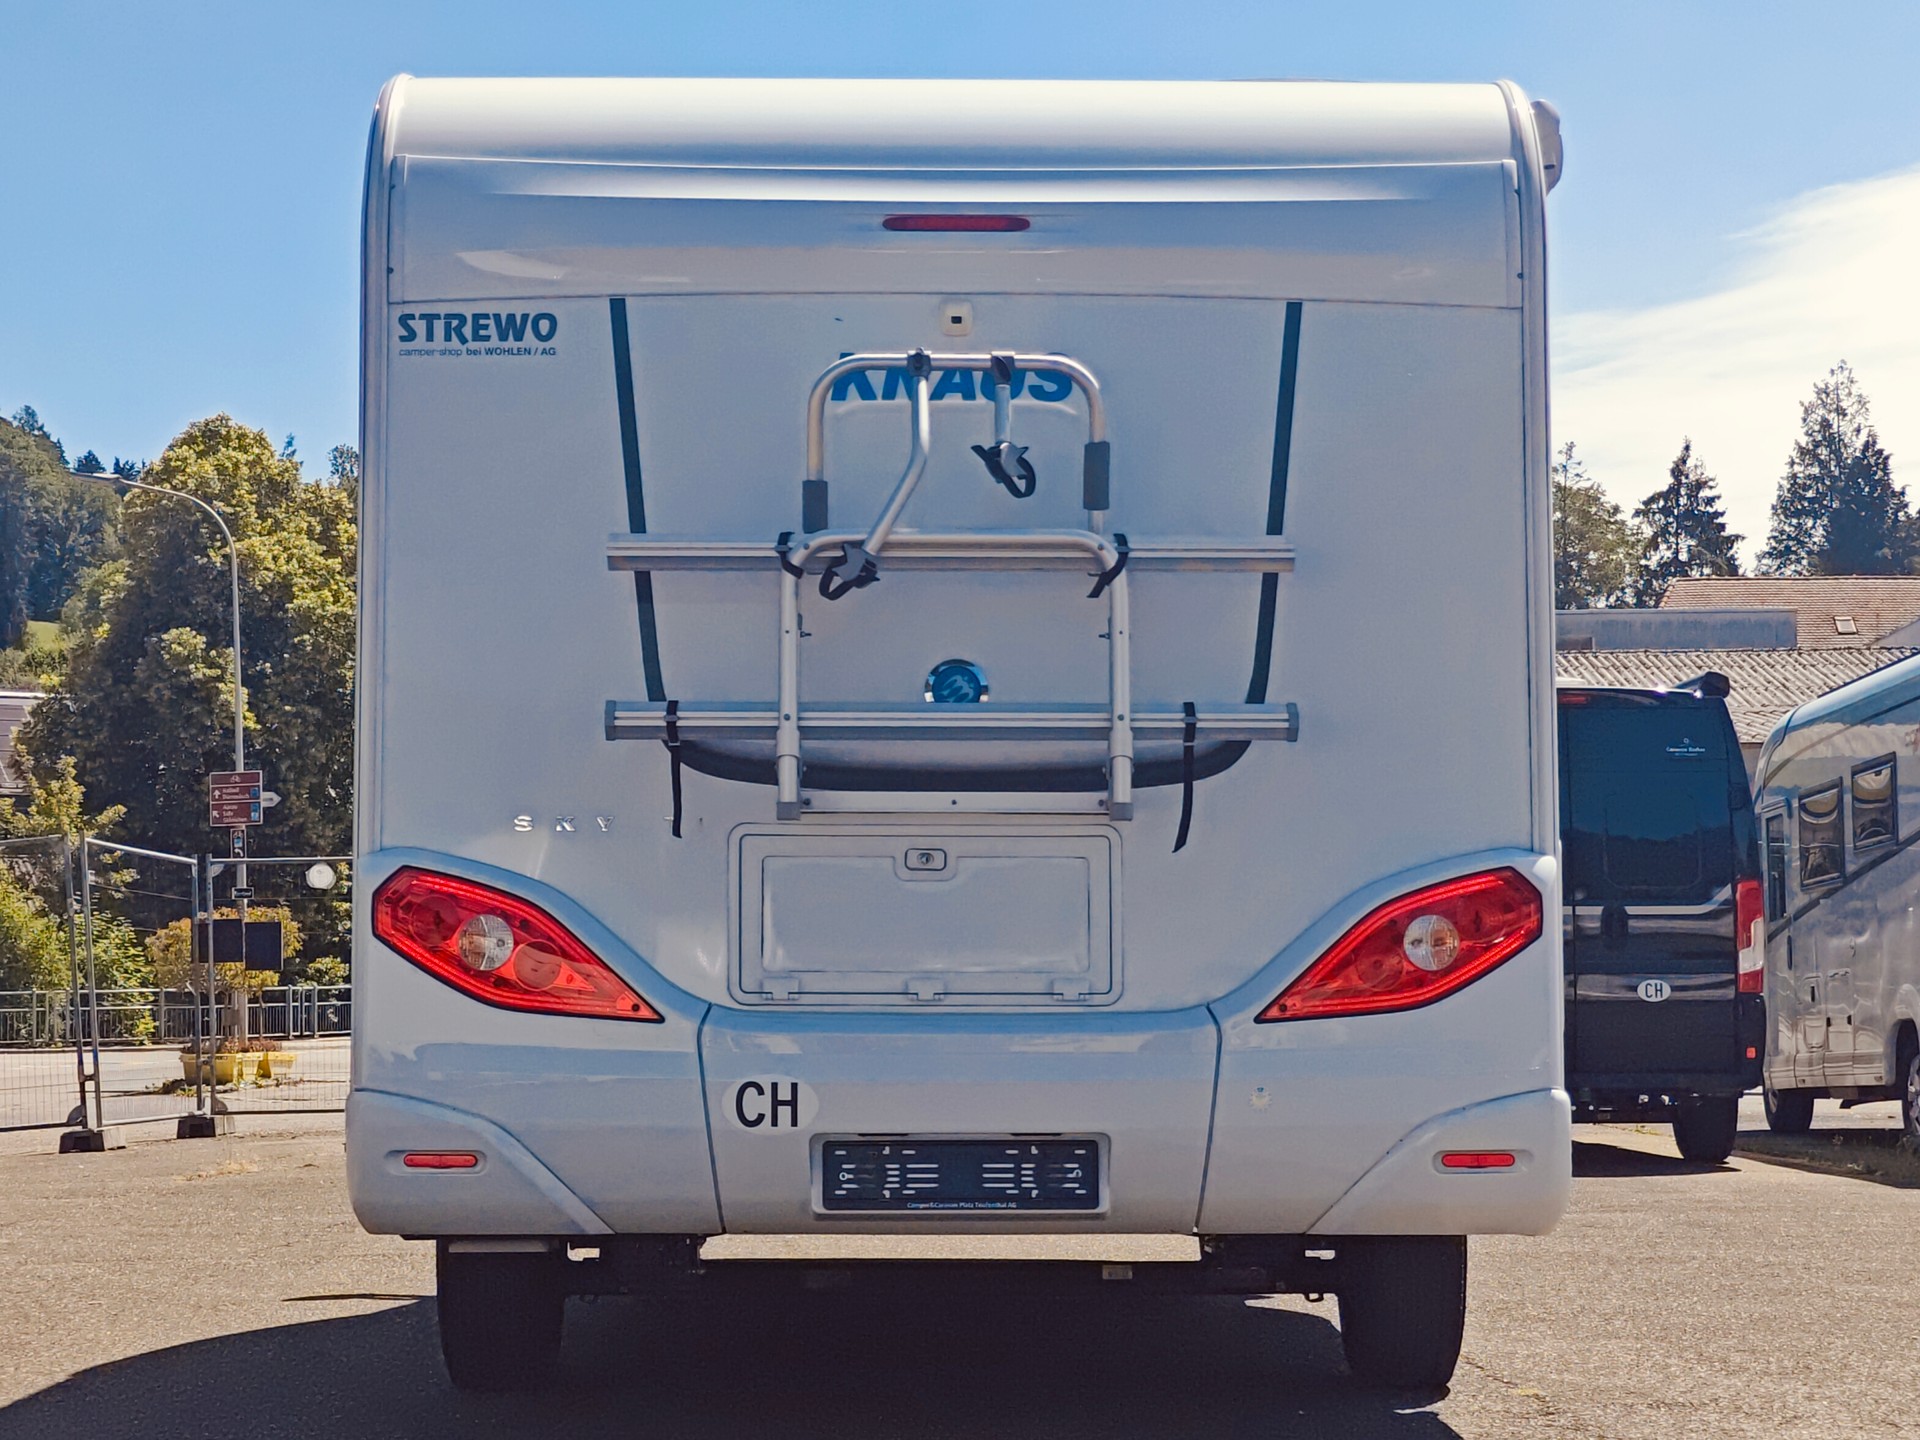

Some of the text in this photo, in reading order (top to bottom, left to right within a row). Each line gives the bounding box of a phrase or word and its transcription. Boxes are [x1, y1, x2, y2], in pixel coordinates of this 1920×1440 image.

[398, 312, 558, 346] STREWO
[466, 346, 482, 356] bei
[484, 347, 532, 356] WOHLEN
[540, 347, 557, 356] AG
[1645, 982, 1664, 999] CH
[735, 1080, 799, 1129] CH
